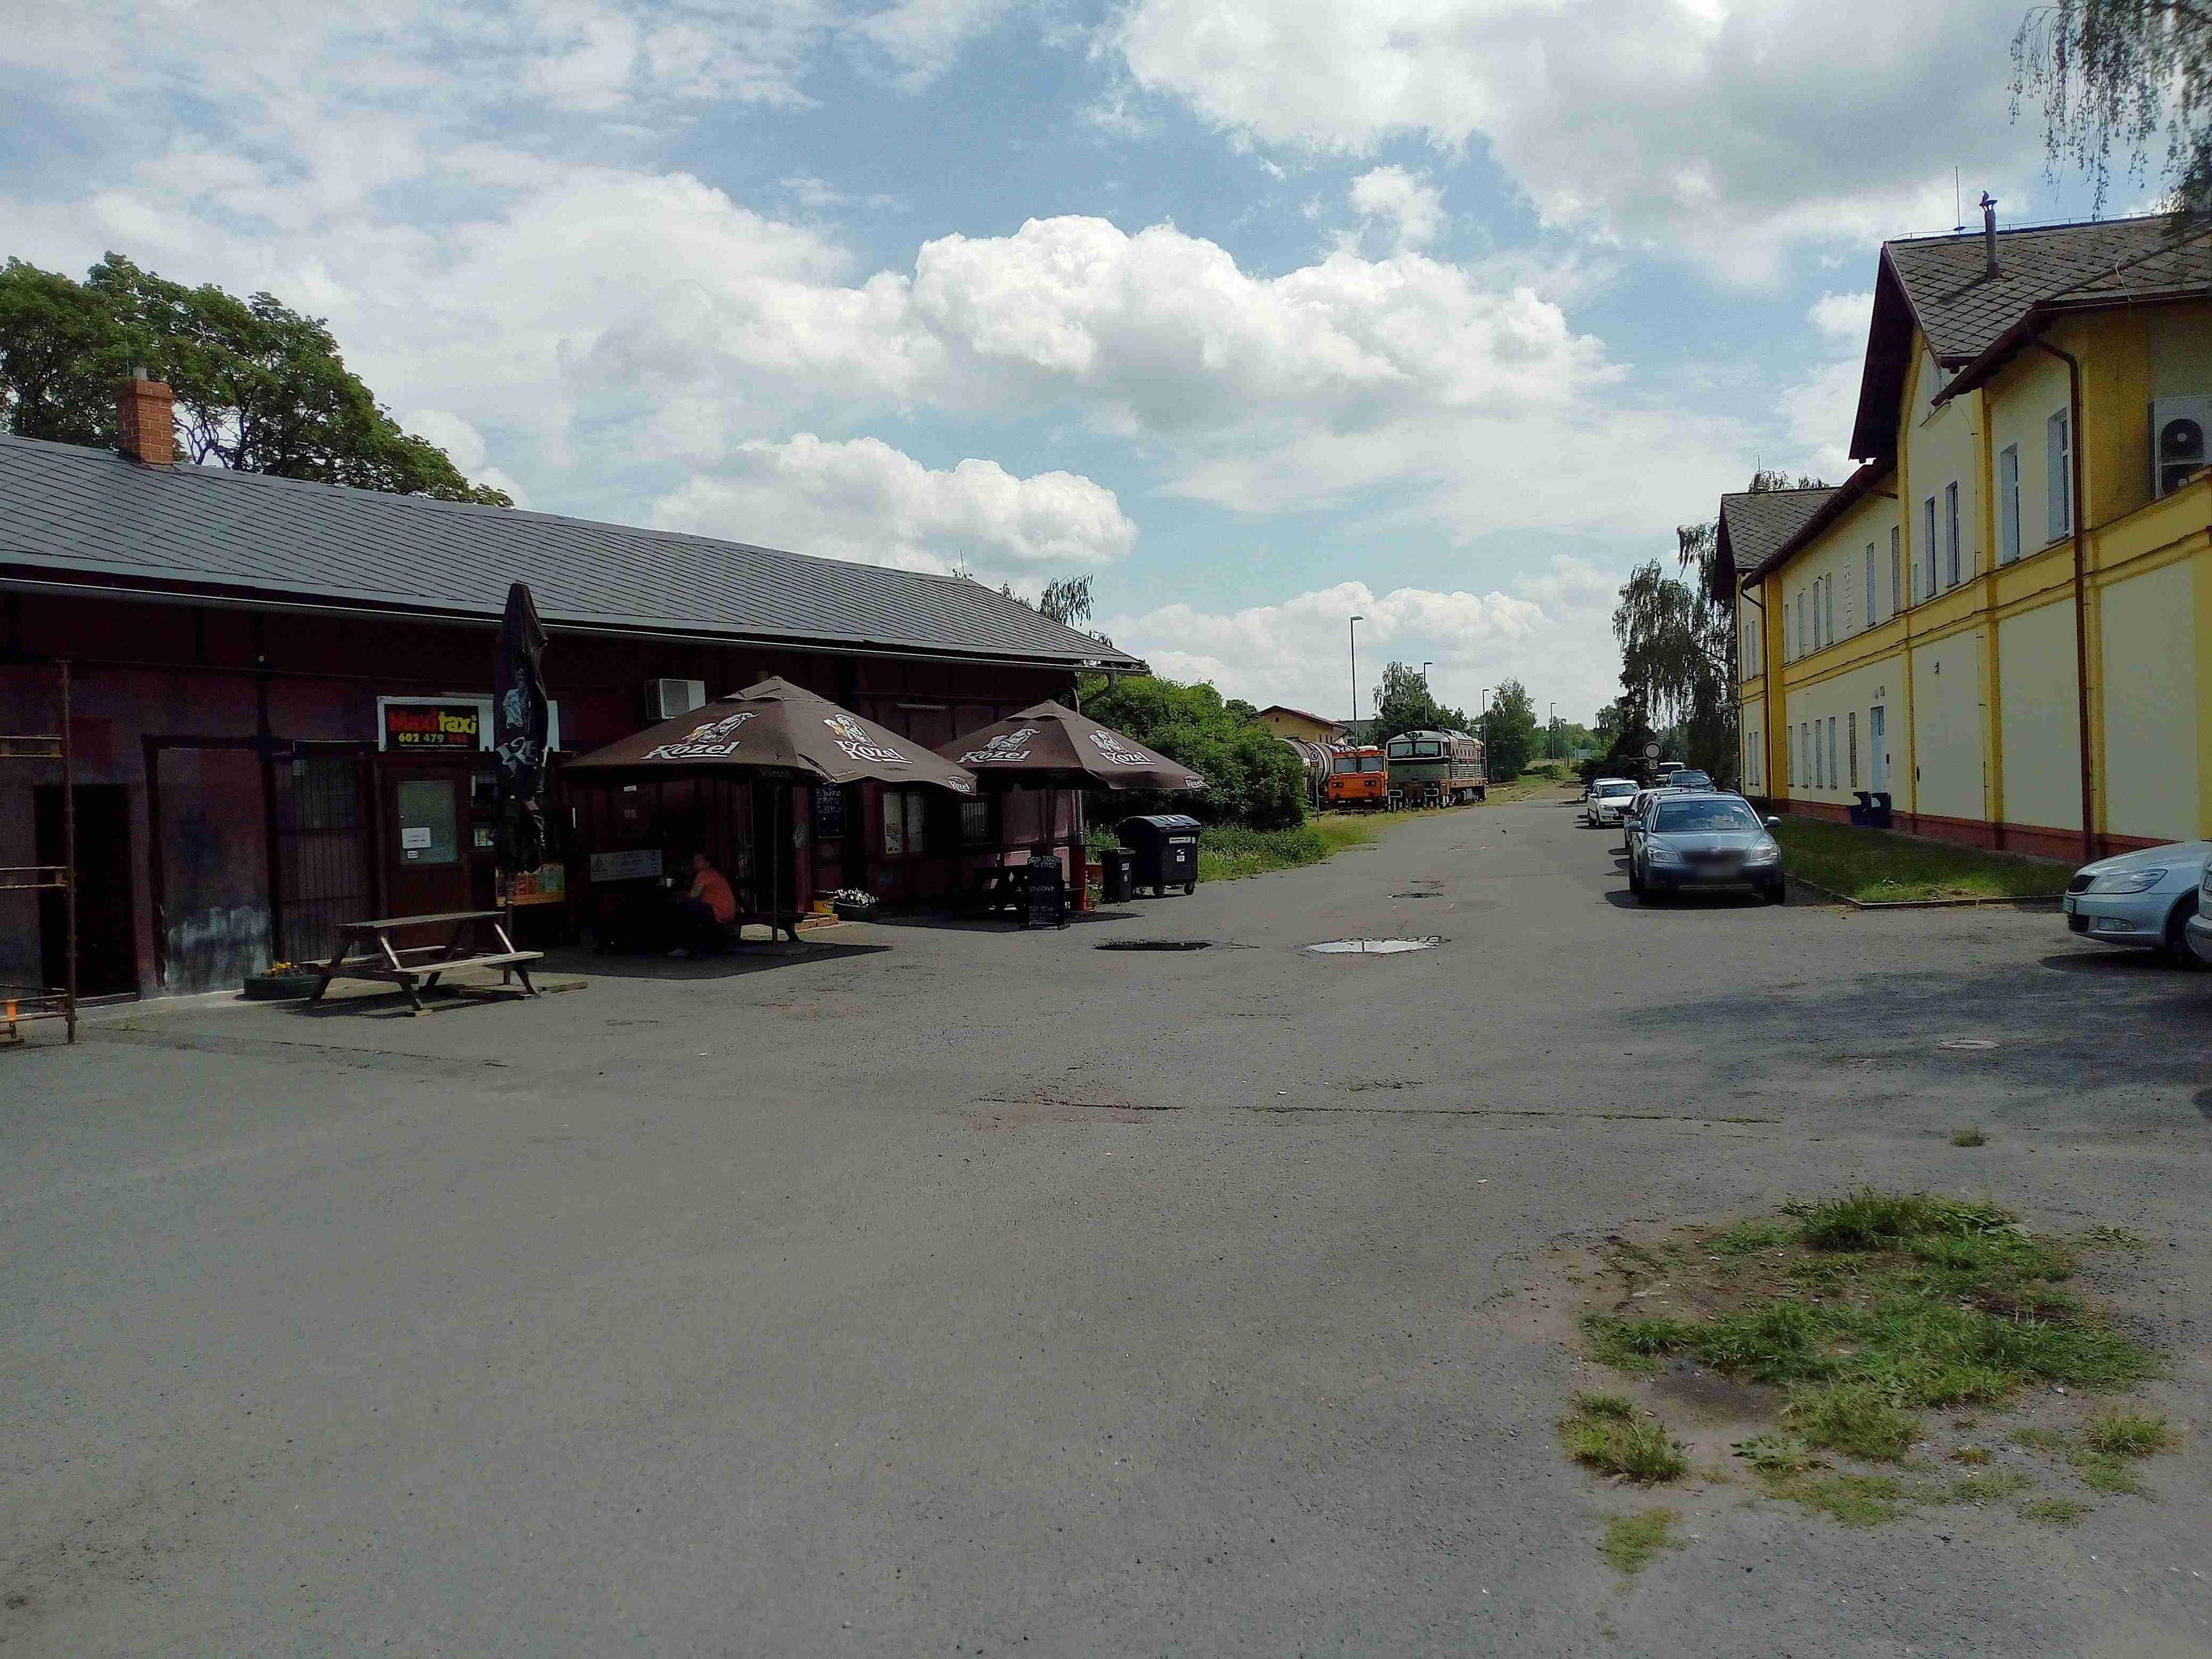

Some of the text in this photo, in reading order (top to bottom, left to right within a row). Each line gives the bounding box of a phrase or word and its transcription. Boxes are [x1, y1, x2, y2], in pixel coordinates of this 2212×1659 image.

[398, 733, 419, 743] 602
[424, 734, 444, 743] 479
[640, 741, 740, 759] Kozel
[833, 740, 912, 763] Kozel
[955, 750, 1031, 763] Kozel
[1099, 751, 1155, 765] Kozel
[948, 780, 971, 792] Kozel
